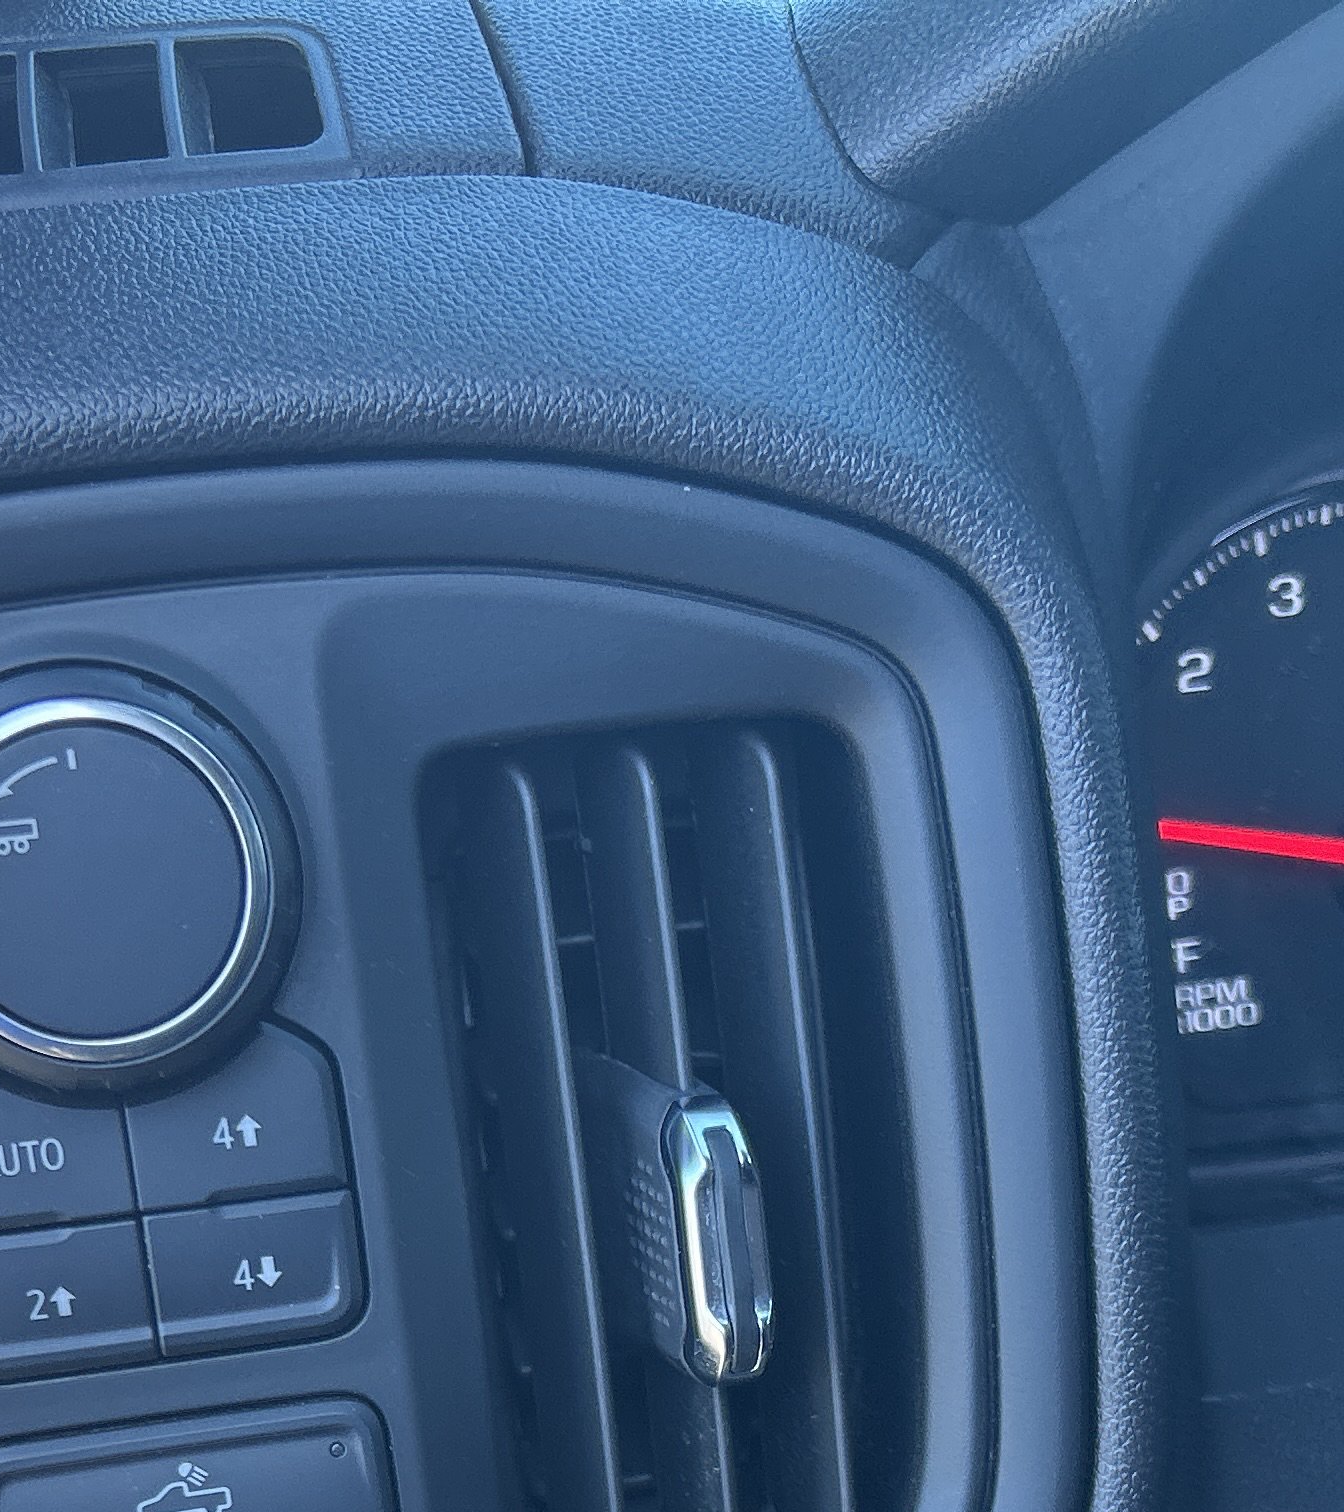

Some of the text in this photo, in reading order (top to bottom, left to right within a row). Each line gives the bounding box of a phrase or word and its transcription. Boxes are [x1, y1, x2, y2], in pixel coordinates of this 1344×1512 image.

[1266, 574, 1305, 618] 3
[1176, 648, 1214, 694] 2
[1175, 976, 1249, 1010] RPM
[212, 1116, 235, 1151] 4
[232, 1258, 255, 1291] 4
[25, 1288, 49, 1321] 2
